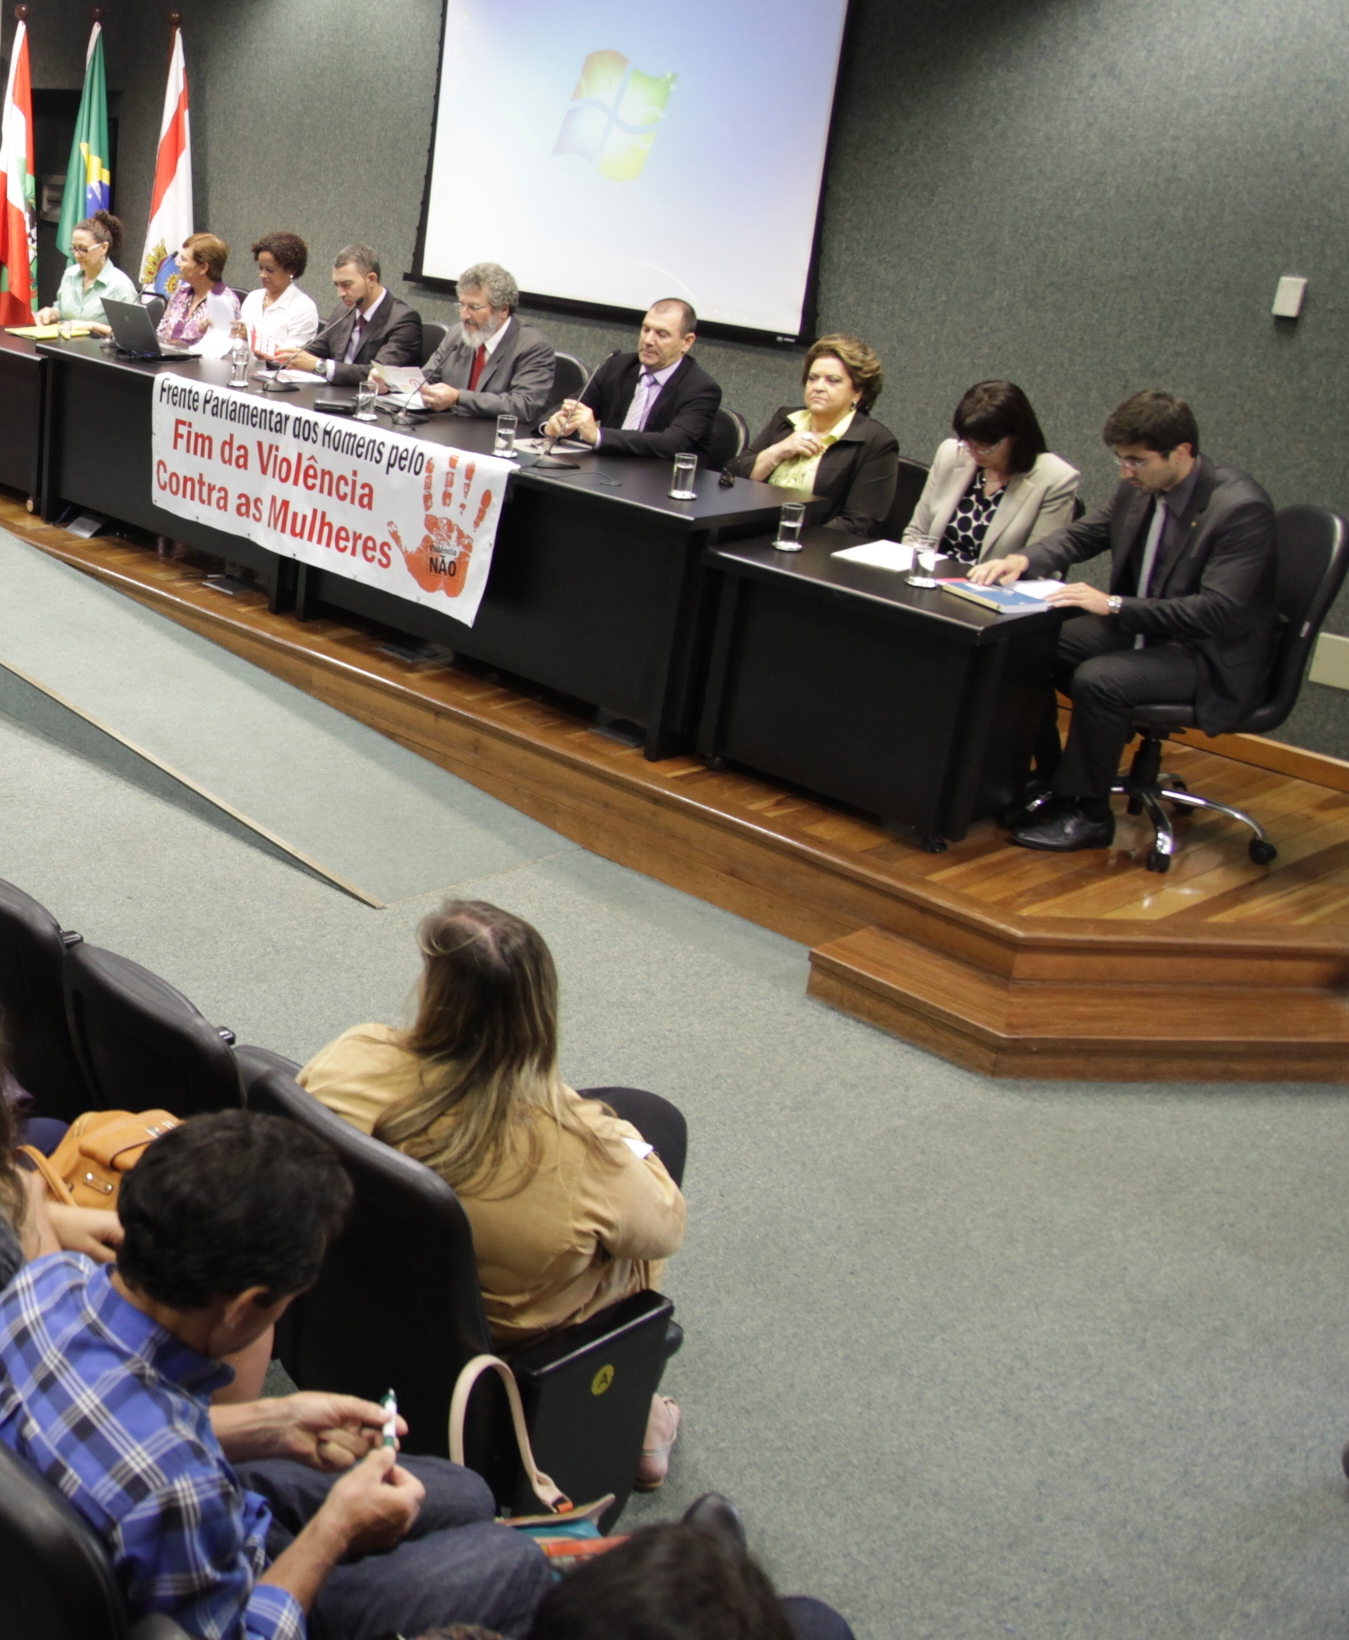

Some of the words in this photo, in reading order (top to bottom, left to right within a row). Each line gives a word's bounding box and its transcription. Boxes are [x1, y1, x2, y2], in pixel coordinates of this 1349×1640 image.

[159, 377, 199, 412] Frente
[202, 389, 290, 436] Parlamentar
[292, 415, 319, 445] dos
[321, 419, 386, 465] Homens
[386, 443, 425, 476] pelo
[172, 418, 214, 460] Fim
[220, 433, 249, 471] da
[256, 440, 375, 511] Violência
[156, 459, 229, 513] Contra
[235, 492, 264, 523] as
[267, 494, 392, 570] Mulheres
[429, 543, 457, 557] Violência
[429, 554, 457, 577] NÃO
[598, 1372, 608, 1389] A
